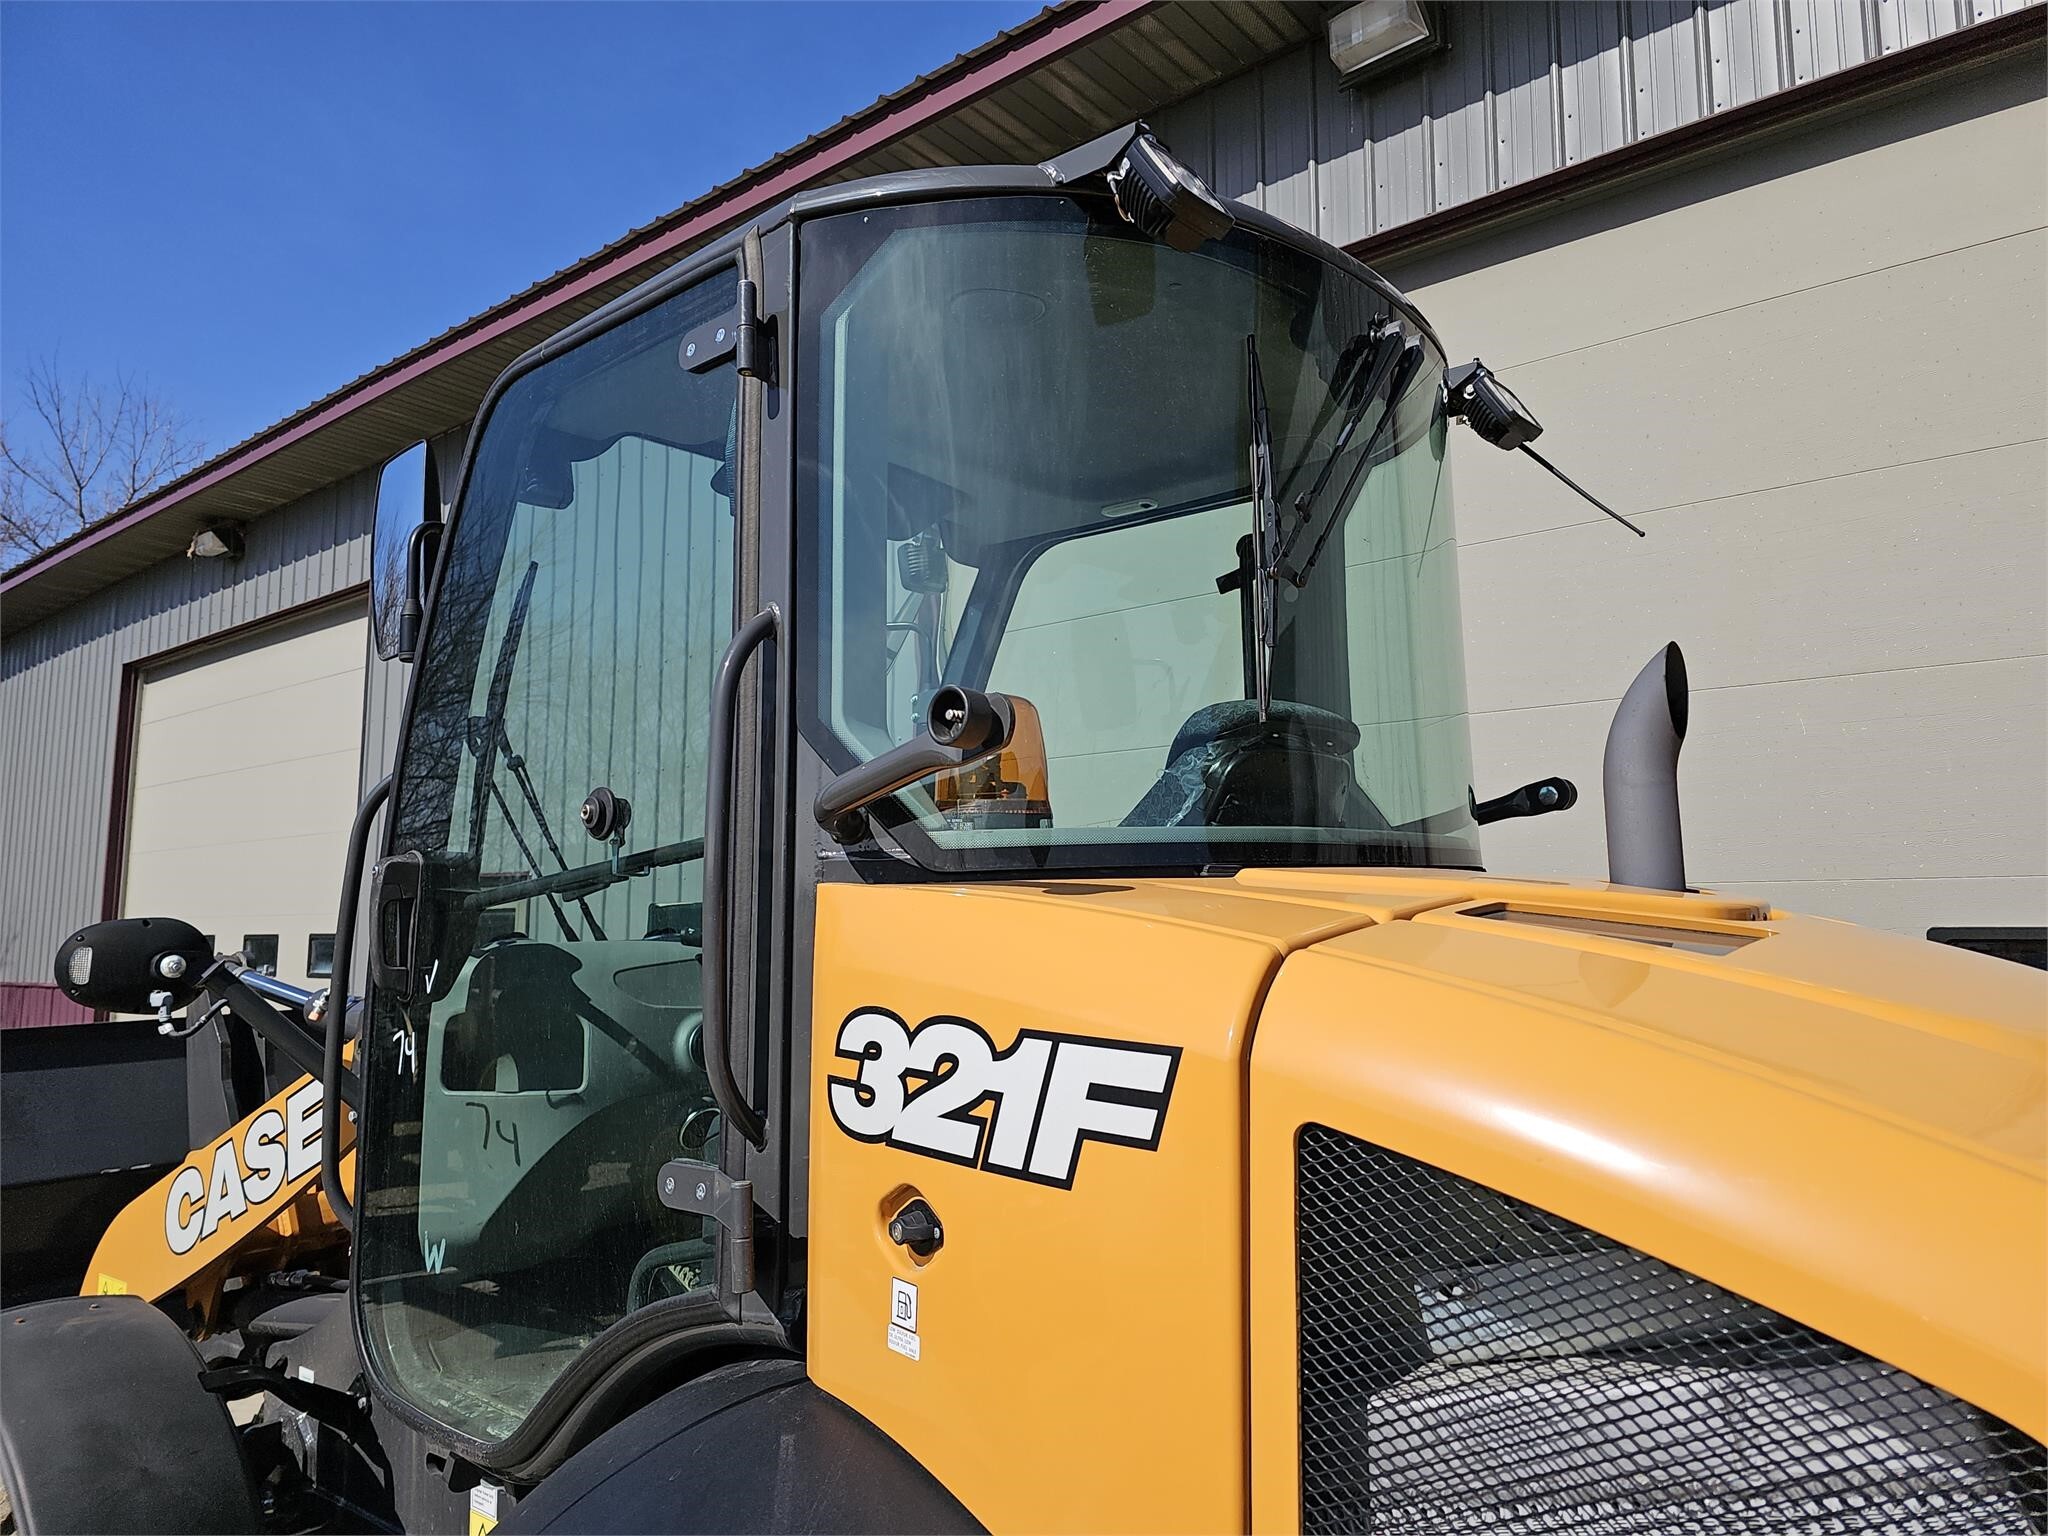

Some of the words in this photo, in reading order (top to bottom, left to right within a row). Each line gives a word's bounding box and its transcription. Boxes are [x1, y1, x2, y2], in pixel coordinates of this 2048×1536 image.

[393, 1029, 416, 1075] 74
[827, 1005, 1184, 1191] 321F
[165, 1078, 325, 1256] CASE
[466, 1101, 520, 1167] 74
